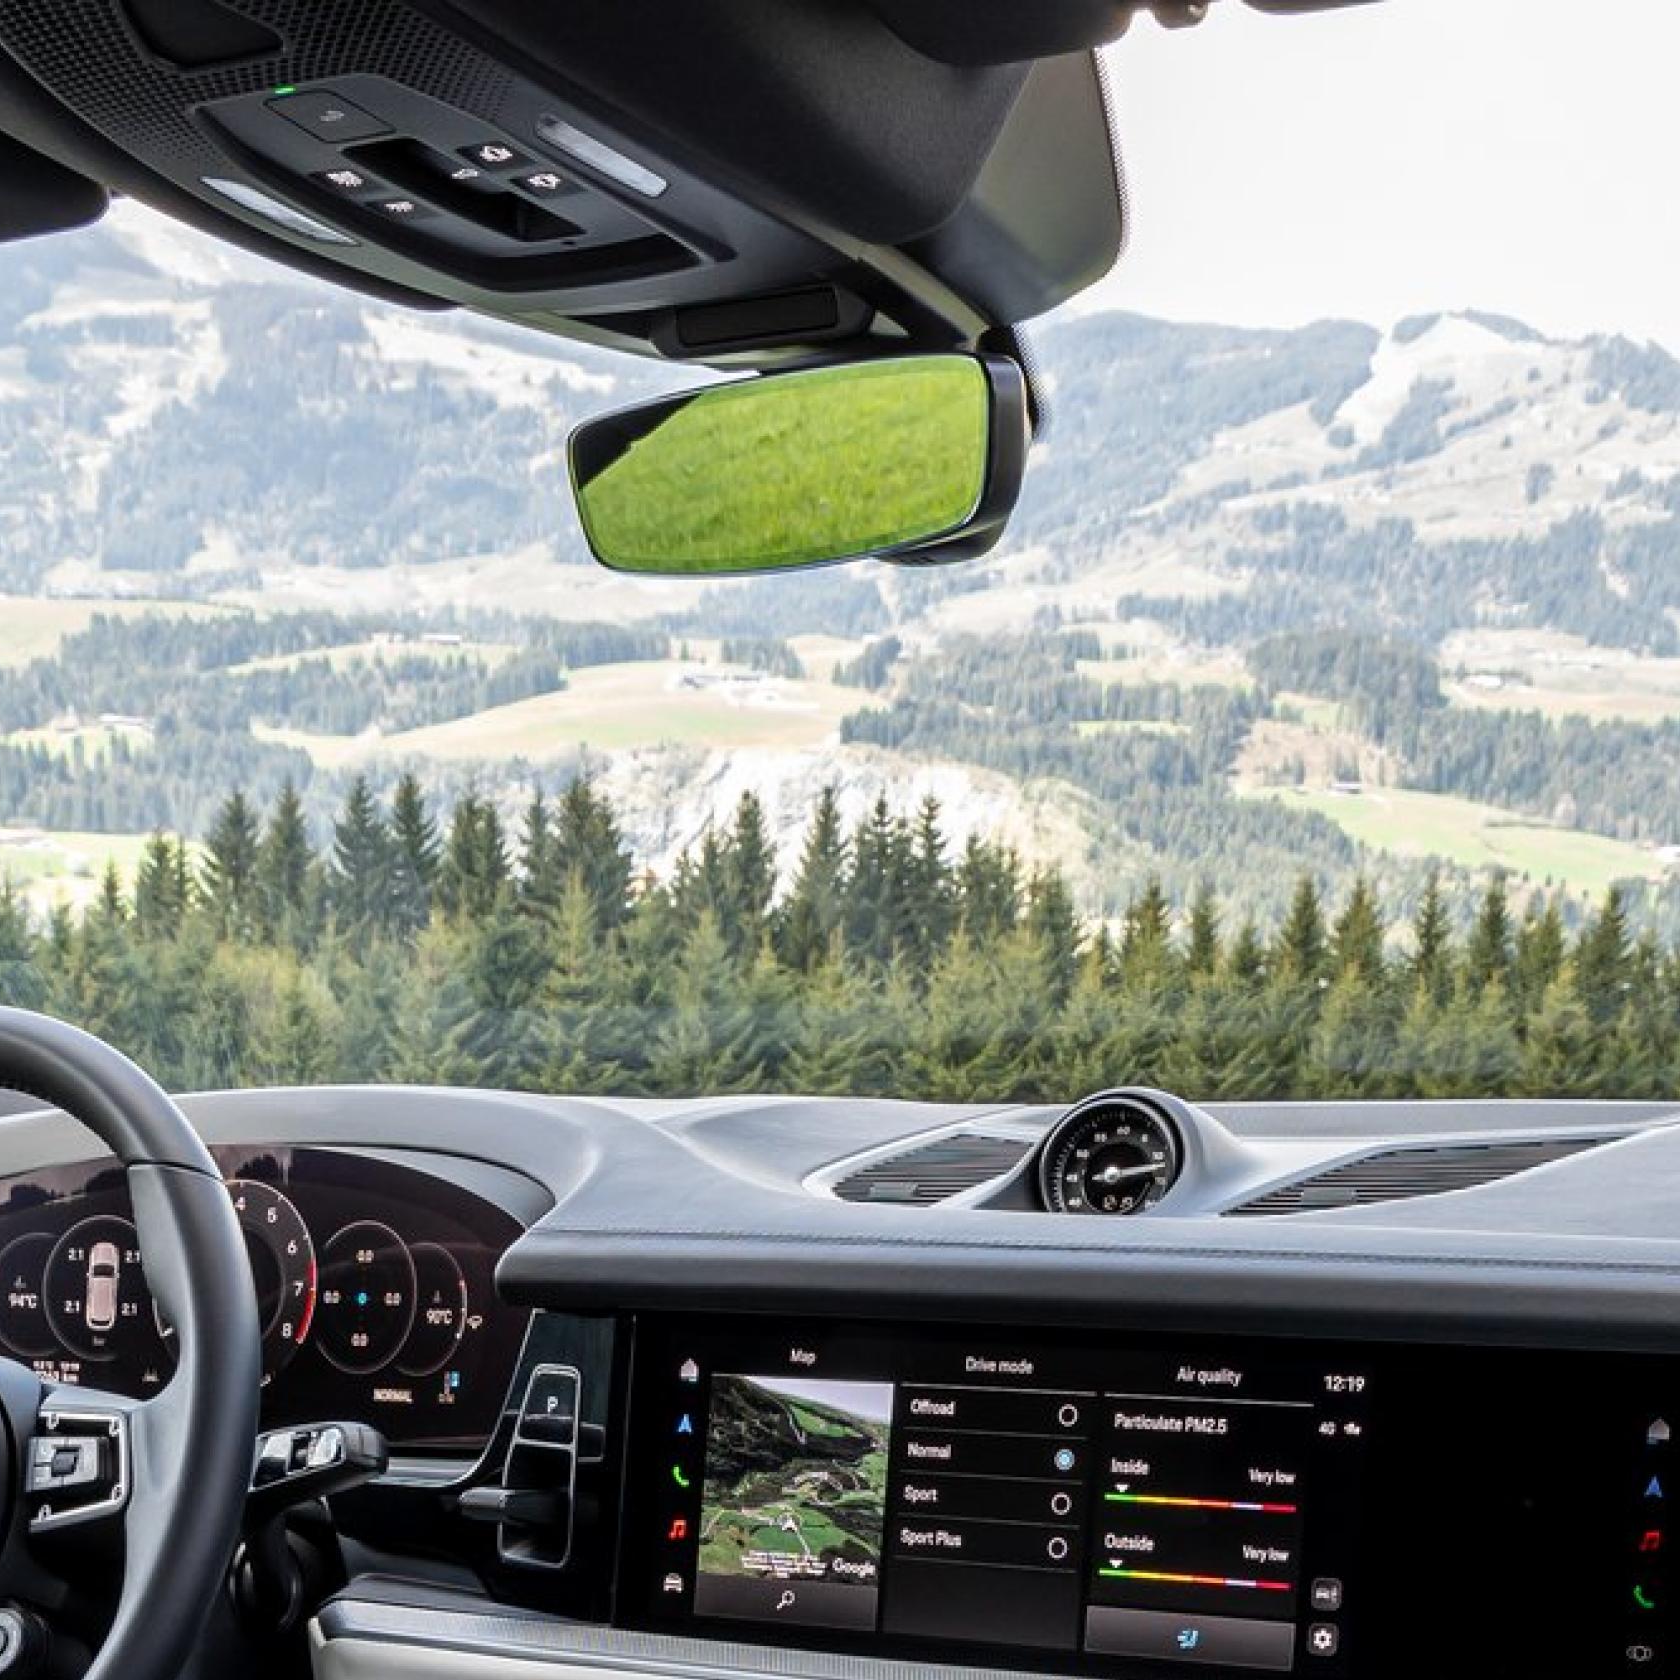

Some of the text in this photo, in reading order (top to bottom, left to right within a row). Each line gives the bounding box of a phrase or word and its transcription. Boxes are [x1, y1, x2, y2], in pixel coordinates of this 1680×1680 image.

[267, 1207, 278, 1224] 5
[287, 1239, 298, 1256] 6
[293, 1280, 304, 1297] 7
[282, 1322, 293, 1339] 8
[789, 1347, 816, 1366] Map
[965, 1355, 1034, 1375] Drive mode
[1177, 1365, 1243, 1388] Air quality
[1323, 1374, 1366, 1393] 12:19
[547, 1395, 559, 1413] P
[910, 1398, 956, 1416] Offroad
[1114, 1411, 1228, 1435] Particulate PM2.5
[907, 1441, 952, 1459] Normal
[1111, 1456, 1150, 1476] Inside
[1247, 1467, 1296, 1486] Very low
[904, 1484, 938, 1504] Sport
[900, 1527, 962, 1548] Sport Plus
[1104, 1532, 1156, 1552] Outside
[1242, 1544, 1290, 1563] Very low
[831, 1556, 876, 1579] Google
